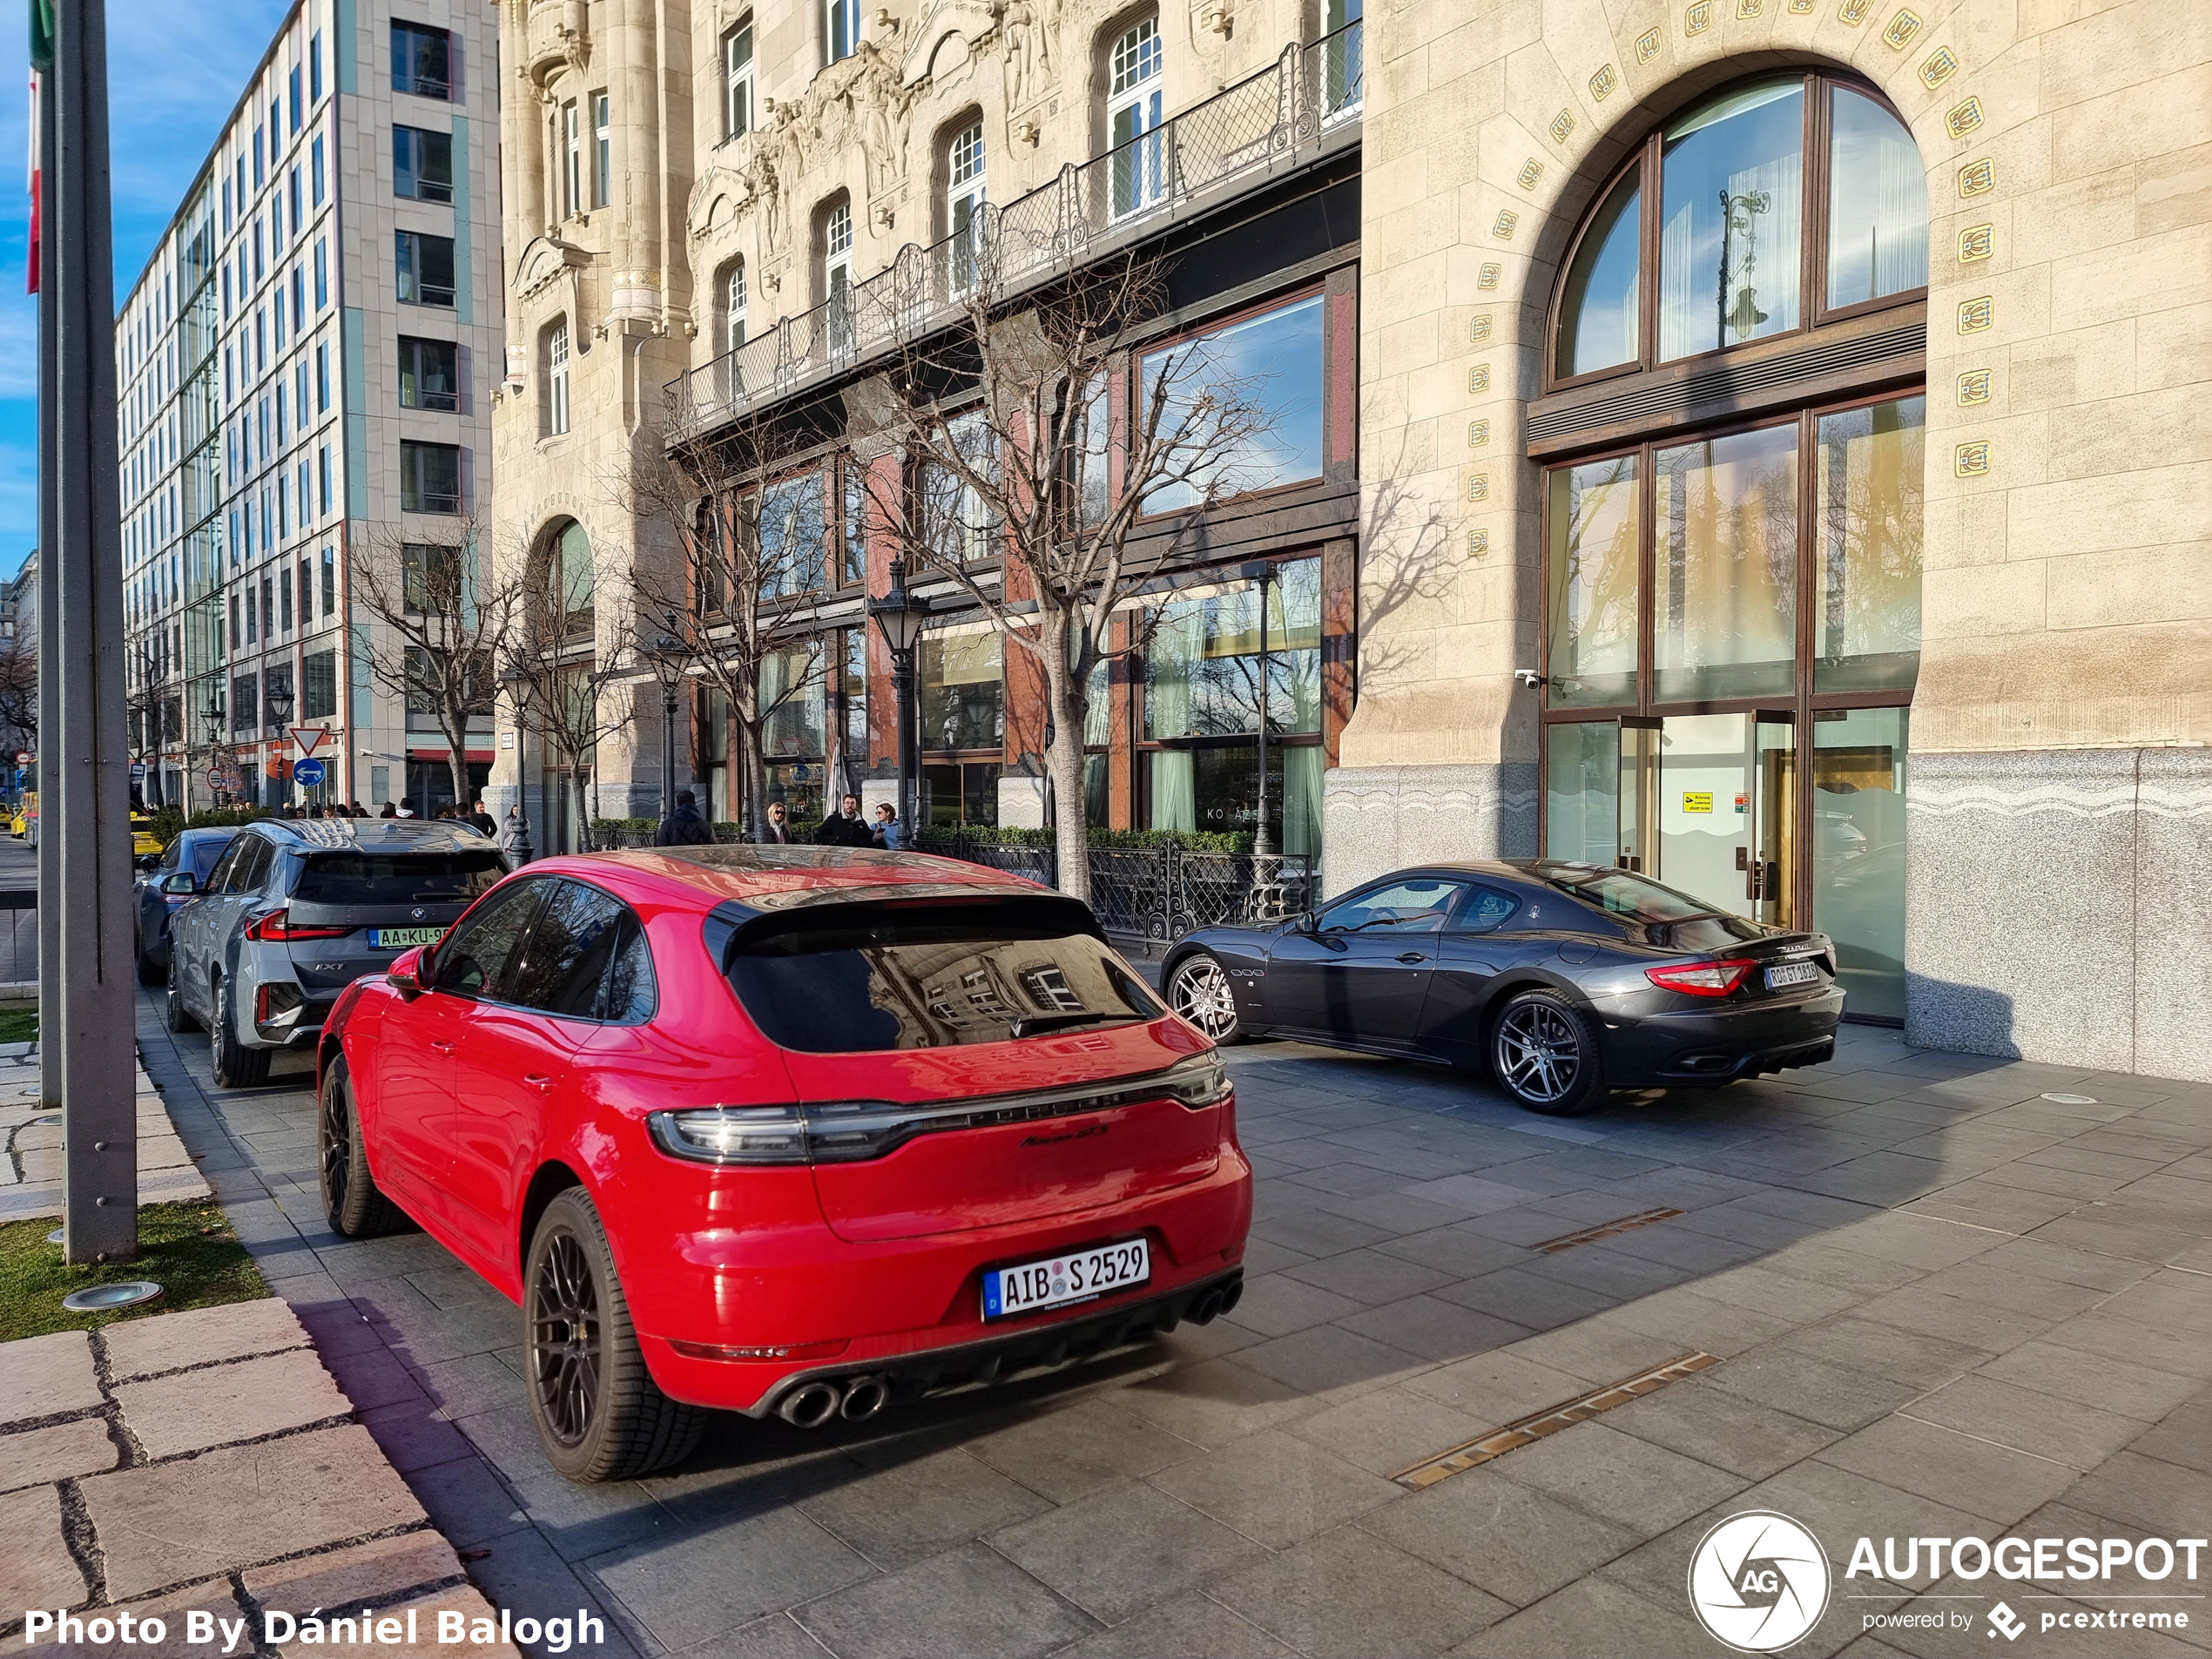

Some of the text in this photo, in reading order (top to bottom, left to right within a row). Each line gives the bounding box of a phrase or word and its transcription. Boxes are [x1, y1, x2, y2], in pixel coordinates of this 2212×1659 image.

[381, 930, 401, 945] AA
[1770, 963, 1817, 985] RO GT 1818
[1005, 1267, 1050, 1308] AIB
[1069, 1259, 1083, 1291] S
[1089, 1245, 1143, 1288] 2529
